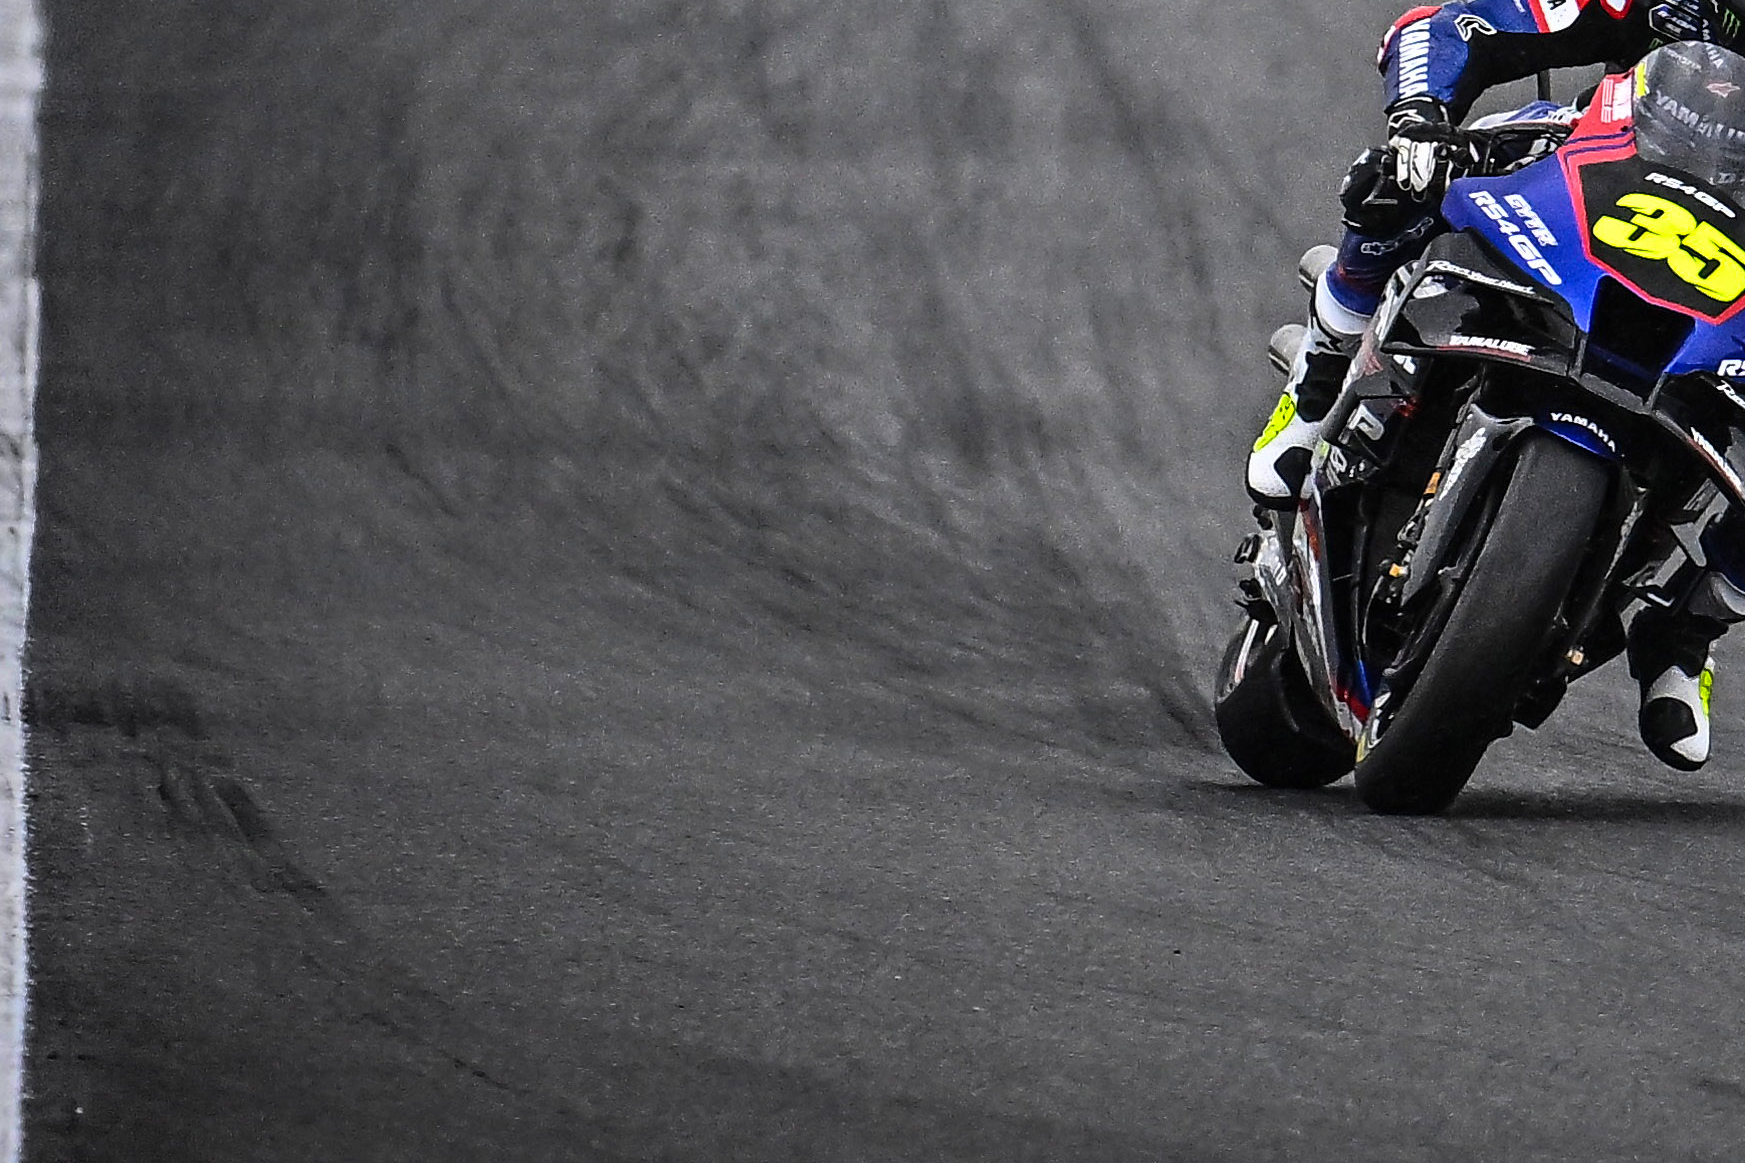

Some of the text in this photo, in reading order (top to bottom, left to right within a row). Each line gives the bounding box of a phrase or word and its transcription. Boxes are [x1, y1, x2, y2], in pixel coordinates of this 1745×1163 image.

[1400, 18, 1430, 99] YAMAHA
[1503, 194, 1558, 247] GYTR
[1644, 172, 1736, 218] RS4GP
[1469, 191, 1562, 285] RS4GP
[1550, 412, 1616, 452] YAMAHA
